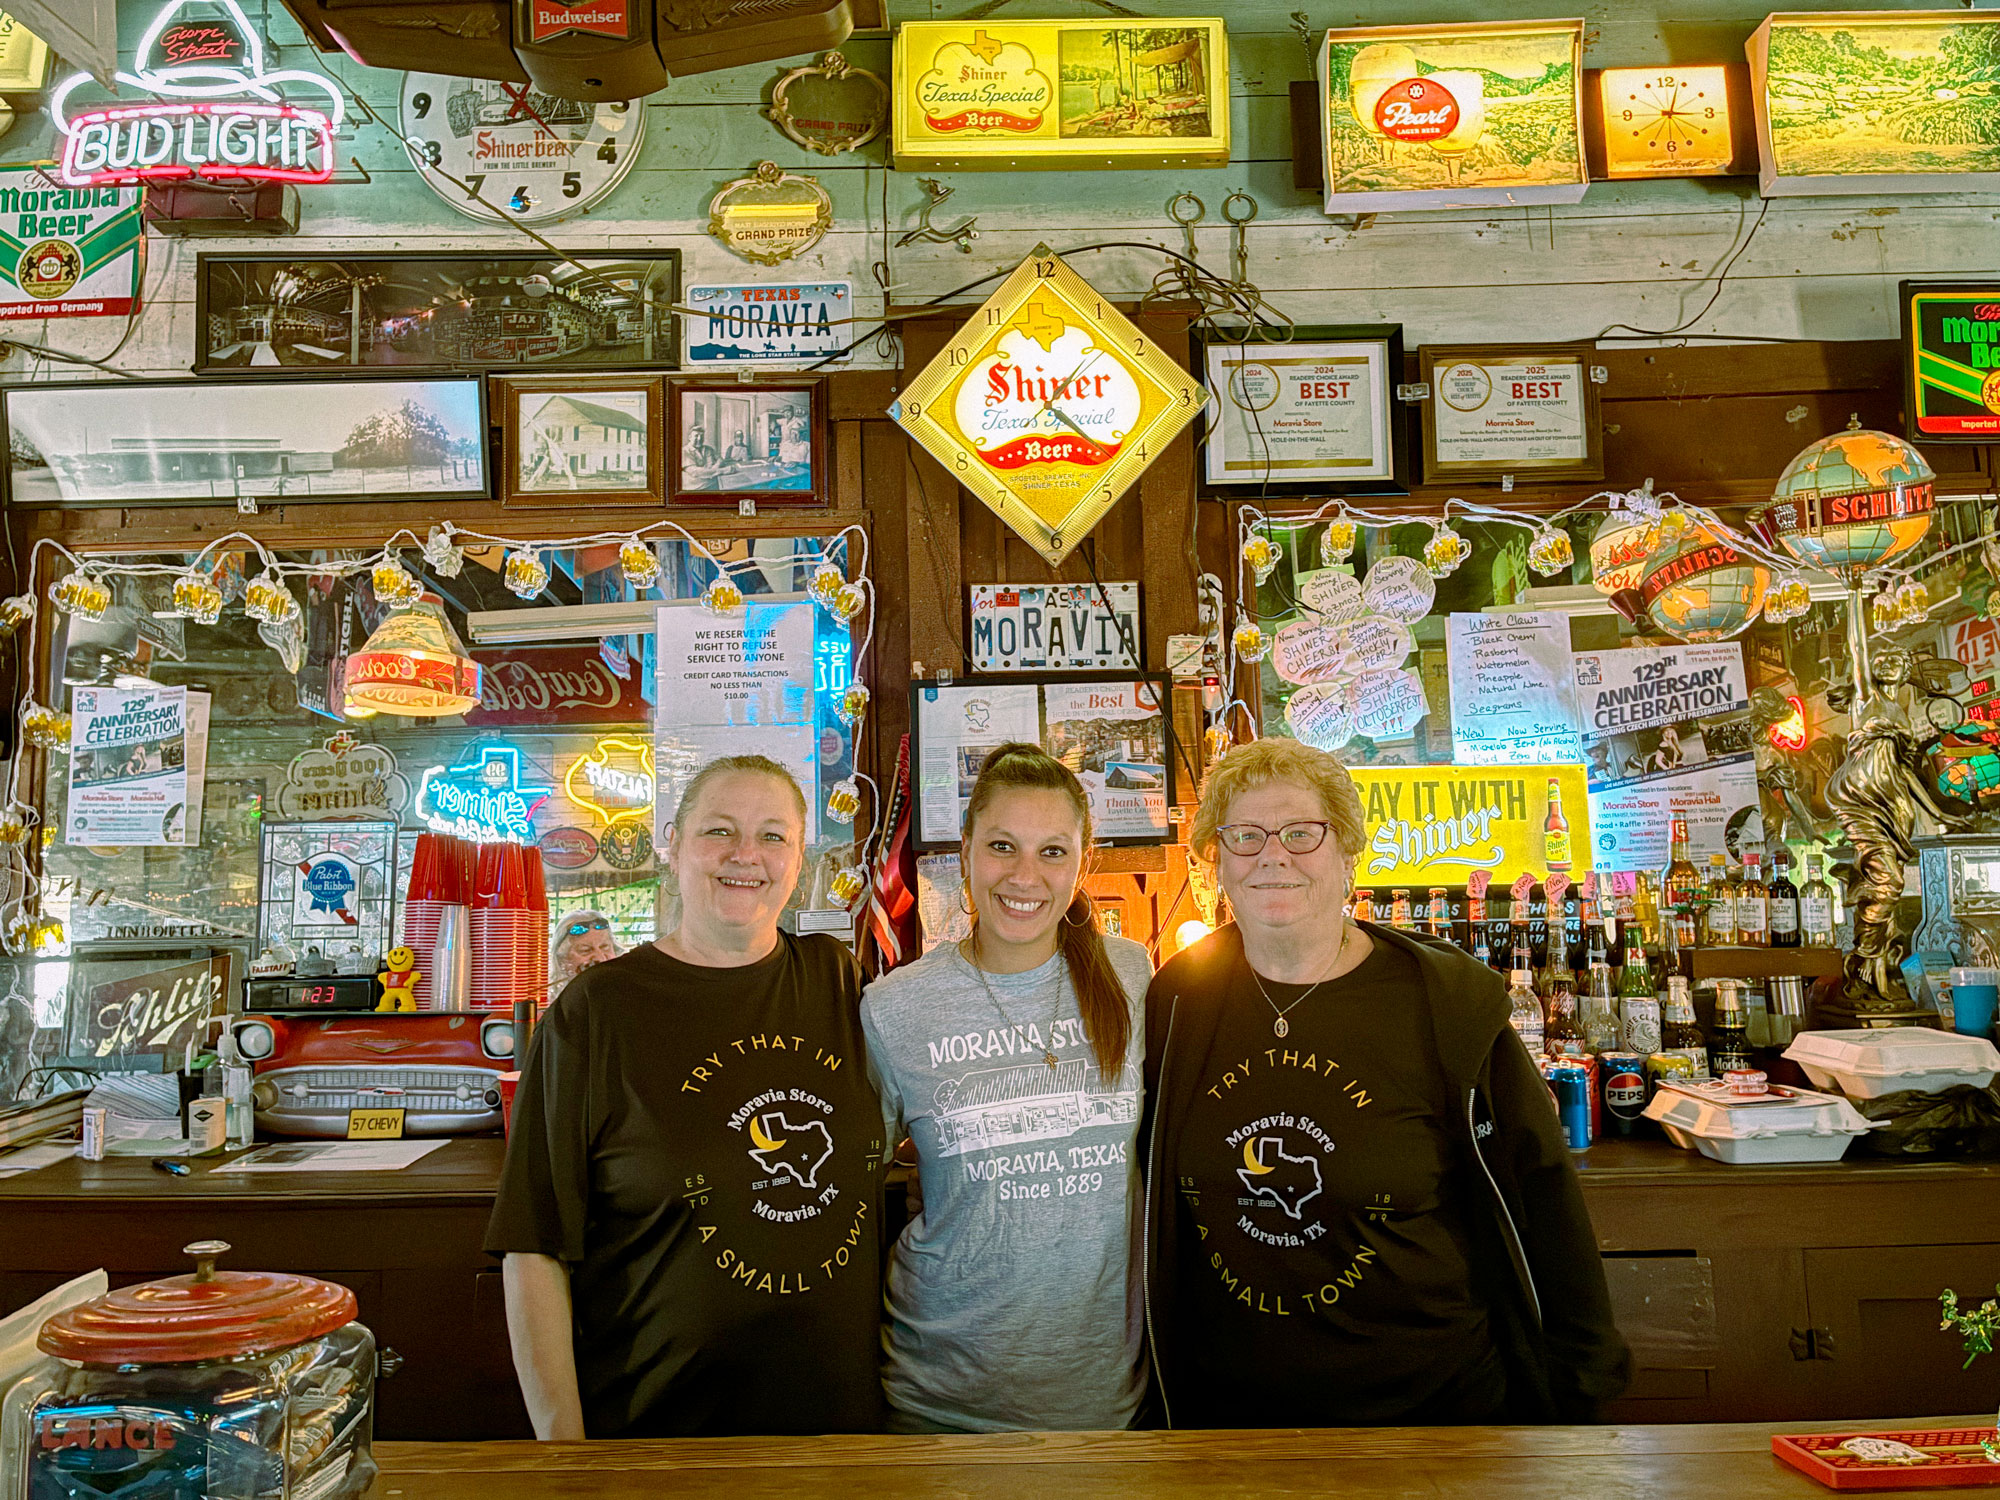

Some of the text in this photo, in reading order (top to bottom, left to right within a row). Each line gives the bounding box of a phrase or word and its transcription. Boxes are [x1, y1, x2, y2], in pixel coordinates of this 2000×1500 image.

[538, 11, 623, 25] Budweiser
[160, 27, 225, 47] George
[165, 41, 239, 59] Strait
[958, 64, 1008, 83] Shiner
[923, 82, 1046, 107] Texas Special
[965, 112, 1003, 127] Beer
[1383, 102, 1452, 127] Pearl
[1704, 107, 1715, 119] 3
[73, 115, 316, 171] BUD LIGHT
[476, 130, 533, 160] Shiner
[597, 137, 617, 164] 4
[1667, 140, 1677, 152] 6
[18, 214, 93, 238] Beer
[736, 227, 812, 240] GRAND PRIZE
[1035, 262, 1056, 278] 12
[741, 288, 800, 302] TEXAS
[35, 301, 103, 316] from Germany
[985, 307, 1003, 326] 11
[508, 313, 537, 325] JAX
[708, 302, 831, 339] MORAVIA
[949, 347, 968, 367] 10
[1314, 366, 1334, 374] 2024
[984, 362, 1111, 407] Shiner
[1300, 382, 1350, 400] BEST
[1512, 382, 1562, 399] BEST
[910, 402, 922, 422] 9
[982, 409, 1038, 431] Texas
[1273, 418, 1322, 427] Moravia Store
[1485, 418, 1535, 427] Moravia Store
[1961, 420, 1997, 428] Imported
[1024, 440, 1072, 460] Beer
[956, 452, 968, 471] 8
[1832, 484, 1934, 523] SCHLITZ
[1312, 581, 1357, 604] SHINER
[975, 608, 1136, 656] MORAVIA
[1469, 615, 1539, 632] White Claws
[695, 629, 776, 640] WE RESERVE THE
[694, 641, 778, 651] RIGHT TO REFUSE
[1284, 636, 1332, 659] SHINER
[687, 653, 785, 664] SERVICE TO ANYONE
[1476, 660, 1529, 670] Watermelon
[683, 672, 709, 680] CREDIT
[733, 670, 789, 678] TRANSACTIONS
[1360, 673, 1384, 684] Now
[1476, 672, 1523, 683] Pineapple
[1633, 656, 1677, 682] 129TH
[724, 692, 749, 700] $10.00
[1479, 683, 1516, 695] Natural
[1595, 666, 1727, 709] ANNIVERSARY
[122, 695, 154, 713] 129TH
[1070, 694, 1124, 709] the Best
[1360, 684, 1415, 712] SHINER
[1594, 684, 1733, 729] CELEBRATION
[88, 703, 178, 730] ANNIVERSARY
[1306, 700, 1338, 729] SHINER
[1589, 705, 1728, 739] HONORING CZECH HISTORY PRESERVING
[86, 716, 180, 744] CELEBRATION
[1508, 726, 1527, 736] Now
[1105, 797, 1163, 808] Thank You
[1413, 781, 1440, 821] IT
[1447, 780, 1527, 821] WITH
[1603, 800, 1660, 810] Moravia Store
[1670, 795, 1721, 806] Moravia Hall
[1619, 820, 1641, 828] Raffle
[1647, 819, 1668, 827] Silent
[1369, 804, 1502, 875] Shiner
[918, 856, 938, 865] Guest
[313, 865, 343, 880] Pabst
[303, 880, 353, 892] Blue Ribbon
[252, 963, 289, 974] FALSTAFF
[301, 986, 335, 1004] 1:23
[95, 970, 222, 1057] Schlitz
[1626, 1016, 1639, 1040] WHITE
[927, 1023, 1046, 1069] MORAVIA
[681, 1033, 842, 1093] TRY THAT IN
[1714, 1057, 1750, 1071] Modelo
[1207, 1049, 1373, 1109] TRY THAT IN
[727, 1088, 834, 1132] Moravia Store
[352, 1117, 400, 1131] 57 CHEVY
[1224, 1111, 1336, 1153] Moravia Store
[967, 1141, 1127, 1182] MORAVIA, TEXAS
[685, 1174, 706, 1188] ES
[772, 1176, 791, 1187] 1889
[1000, 1172, 1103, 1200] Since 1889
[690, 1195, 709, 1209] TD
[751, 1183, 840, 1223] Moravia, TX
[1236, 1214, 1327, 1247] Moravia, TX
[698, 1200, 868, 1294] A SMALL TOWN
[1197, 1224, 1377, 1315] A SMALL TOWN
[41, 1419, 176, 1450] LANCE
